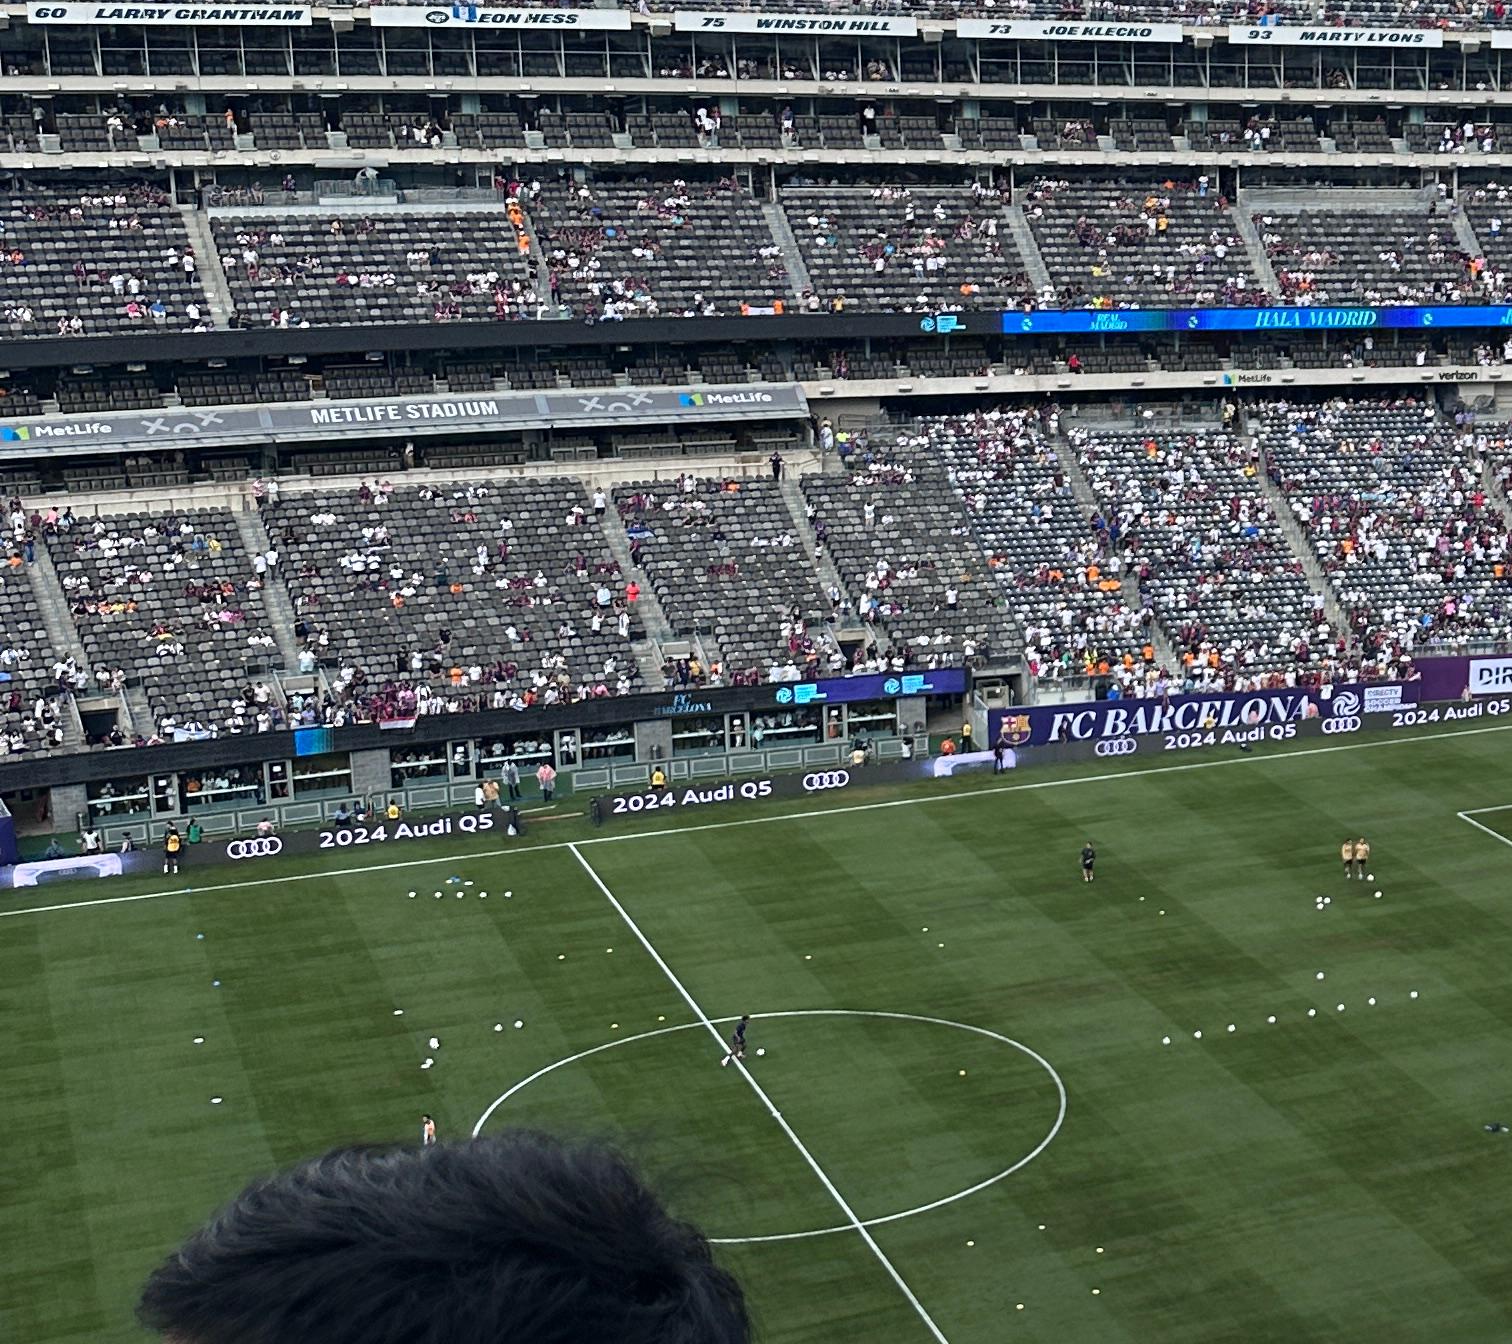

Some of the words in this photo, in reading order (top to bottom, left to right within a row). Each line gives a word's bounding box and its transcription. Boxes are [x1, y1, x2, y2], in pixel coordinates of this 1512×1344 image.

[35, 8, 67, 18] 60
[95, 7, 170, 18] LARRY
[175, 9, 304, 20] GRANTHAM
[524, 14, 578, 23] HESS
[701, 17, 727, 27] 75
[756, 19, 846, 29] WINSTON
[850, 20, 891, 30] HILL
[989, 24, 1012, 34] 73
[1042, 26, 1080, 35] JOE
[1081, 27, 1153, 37] KLECKO
[1247, 30, 1273, 39] 93
[1299, 31, 1365, 41] MARTY
[1368, 33, 1425, 42] LYONS
[1255, 311, 1300, 326] HALA
[1305, 310, 1377, 326] MADRID
[1238, 373, 1272, 383] MetLife
[1439, 369, 1478, 380] verizon
[706, 392, 772, 404] MetLife
[310, 405, 402, 424] METLIFE
[405, 400, 499, 420] STADIUM
[35, 422, 112, 437] MetLife
[1048, 710, 1097, 743] FC
[1101, 695, 1310, 738] BARCELONA
[1392, 709, 1440, 726] 2024
[1443, 702, 1483, 720] Audi
[1486, 699, 1511, 716] Q5
[1164, 731, 1216, 749] 2024
[1220, 727, 1265, 744] Audi
[1269, 724, 1297, 740] Q5
[613, 792, 676, 813] 2024
[681, 785, 734, 806] Audi
[740, 780, 772, 800] Q5
[320, 825, 388, 848] 2024
[394, 817, 452, 839] Audi
[459, 813, 495, 833] Q5
